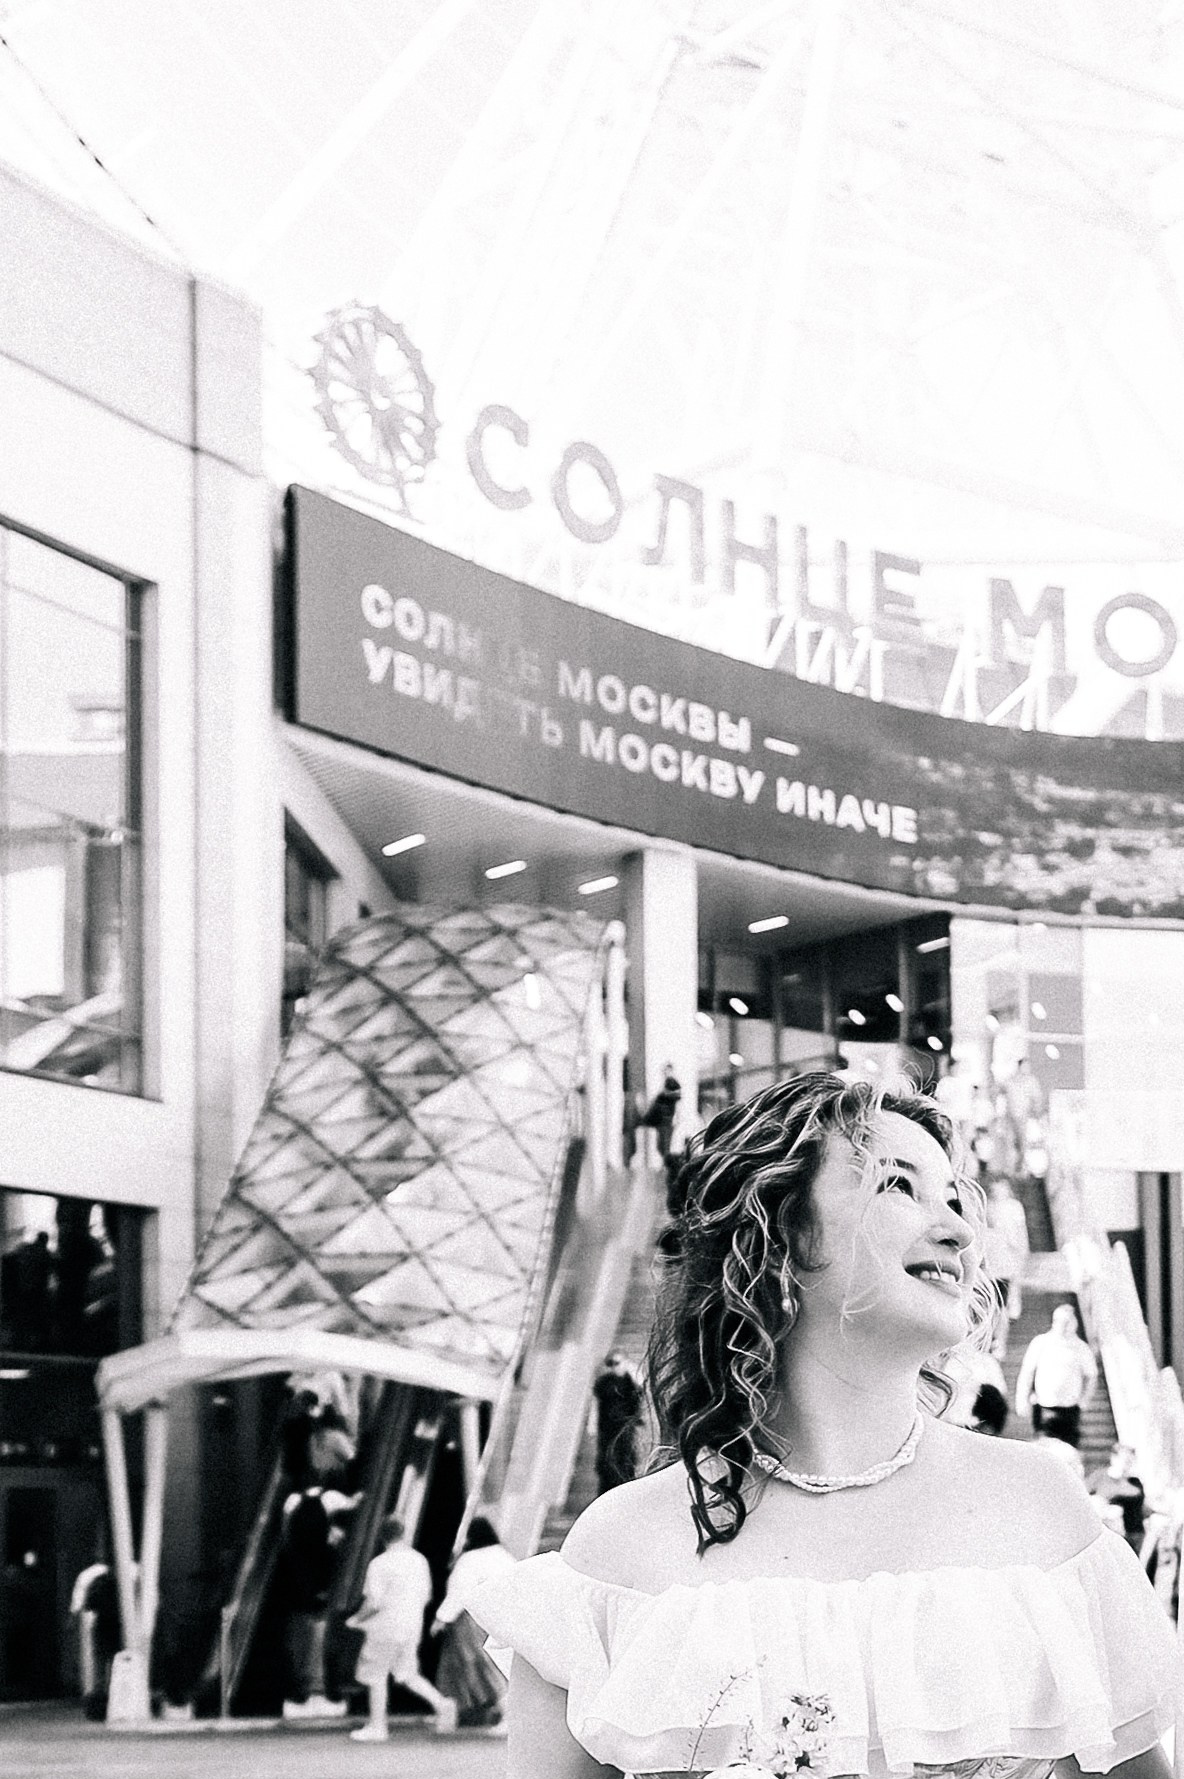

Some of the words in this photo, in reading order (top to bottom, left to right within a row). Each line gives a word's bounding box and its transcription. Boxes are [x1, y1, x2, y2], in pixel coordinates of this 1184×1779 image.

[466, 403, 921, 638] СОЛНЦЕ
[361, 639, 564, 749] УВИДТЬ
[579, 720, 765, 804] МОСКВУ
[775, 777, 919, 844] ИНАЧЕ
[558, 661, 752, 752] МОСКВЫ
